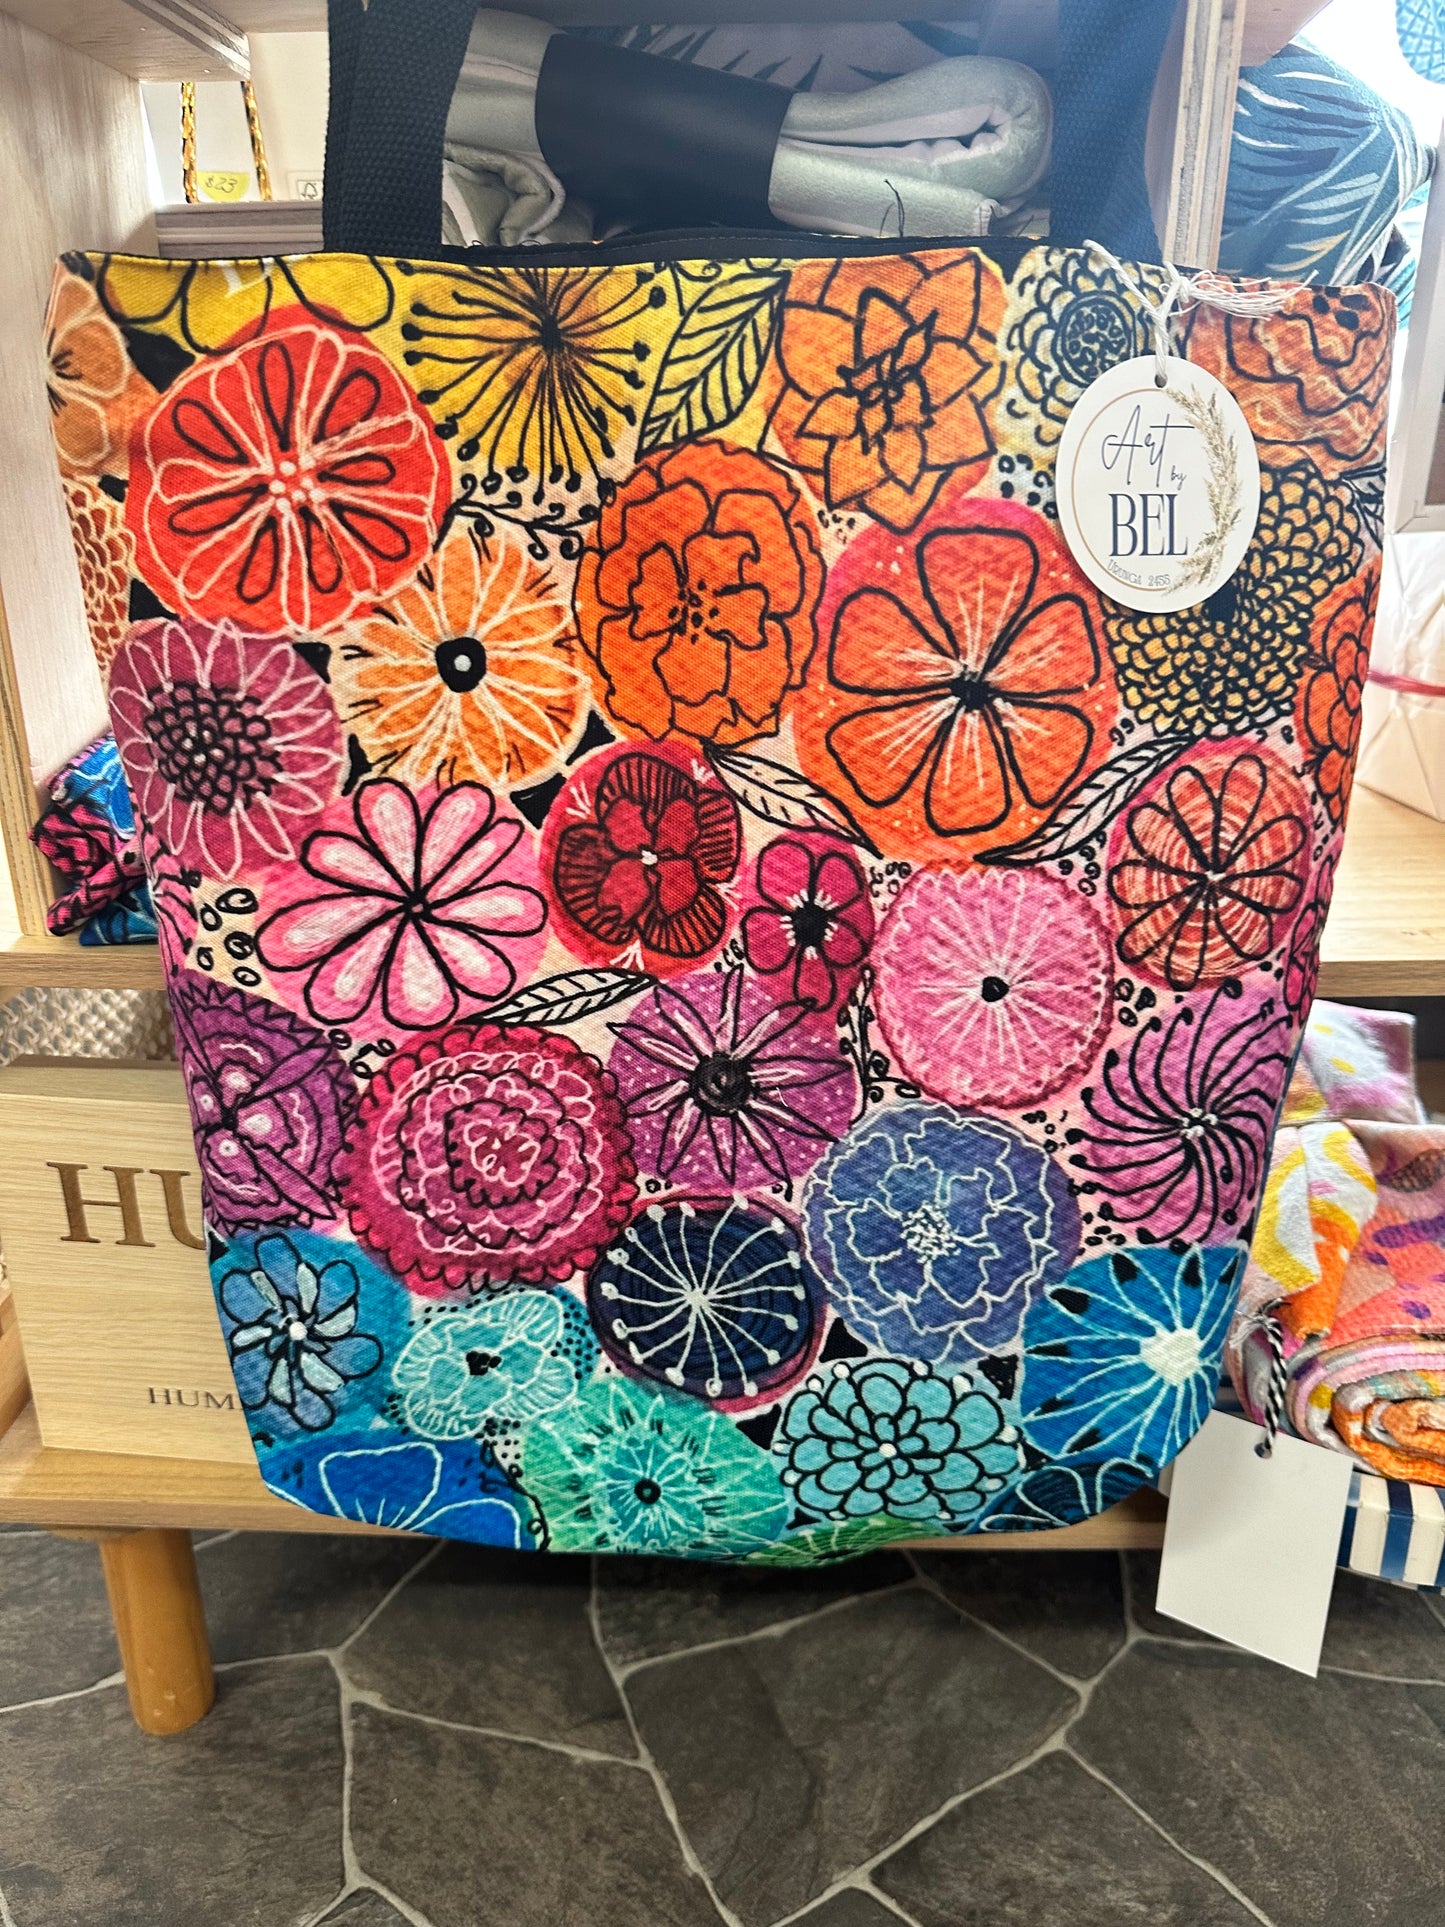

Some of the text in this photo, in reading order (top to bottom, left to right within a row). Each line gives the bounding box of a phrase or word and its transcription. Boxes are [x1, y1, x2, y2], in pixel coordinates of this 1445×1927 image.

[204, 174, 239, 194] $23
[1101, 404, 1195, 488] Art
[1170, 464, 1188, 491] by
[1108, 493, 1188, 557] BEL
[148, 1386, 241, 1411] HUM
